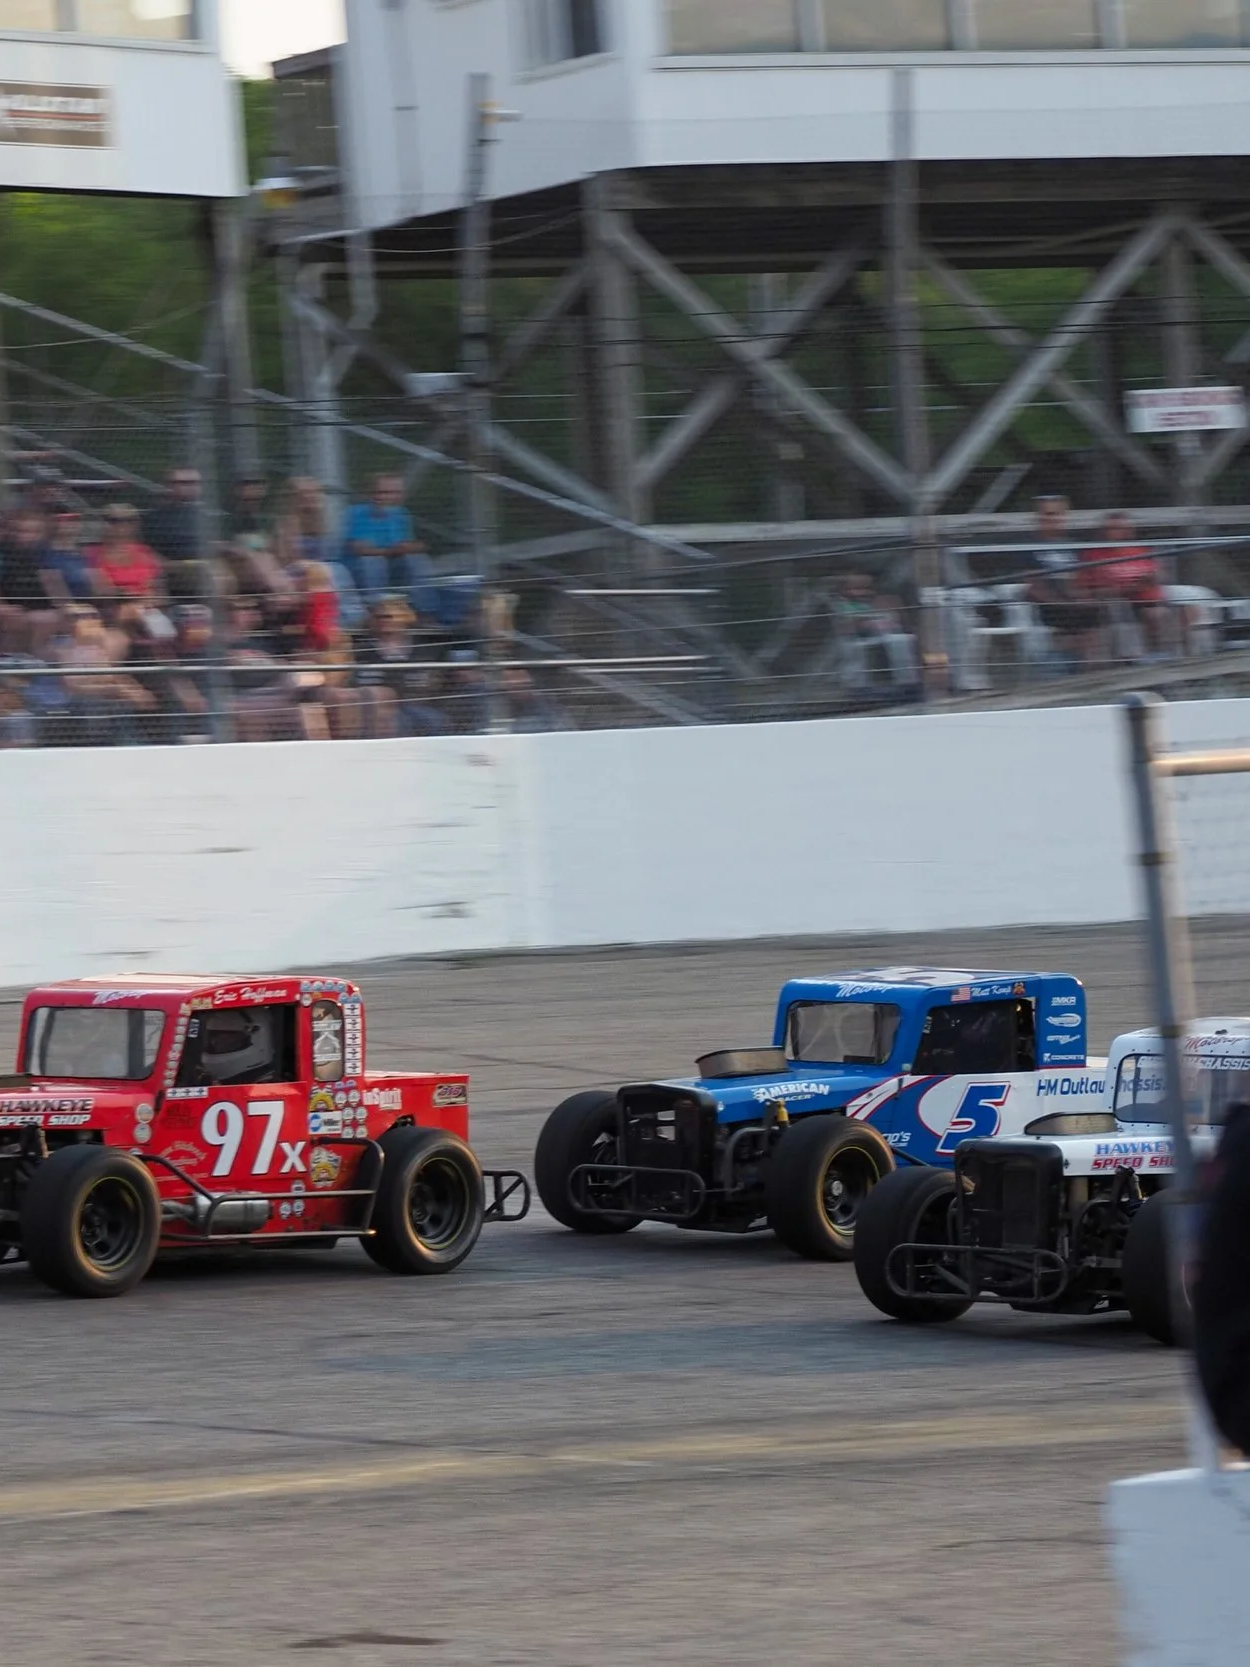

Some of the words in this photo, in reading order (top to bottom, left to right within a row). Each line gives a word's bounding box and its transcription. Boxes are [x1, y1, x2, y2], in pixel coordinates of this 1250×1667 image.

[214, 989, 237, 1005] Eric
[752, 1083, 830, 1103] AMERICAN
[48, 1114, 91, 1125] SHOP
[936, 1078, 1011, 1157] 5
